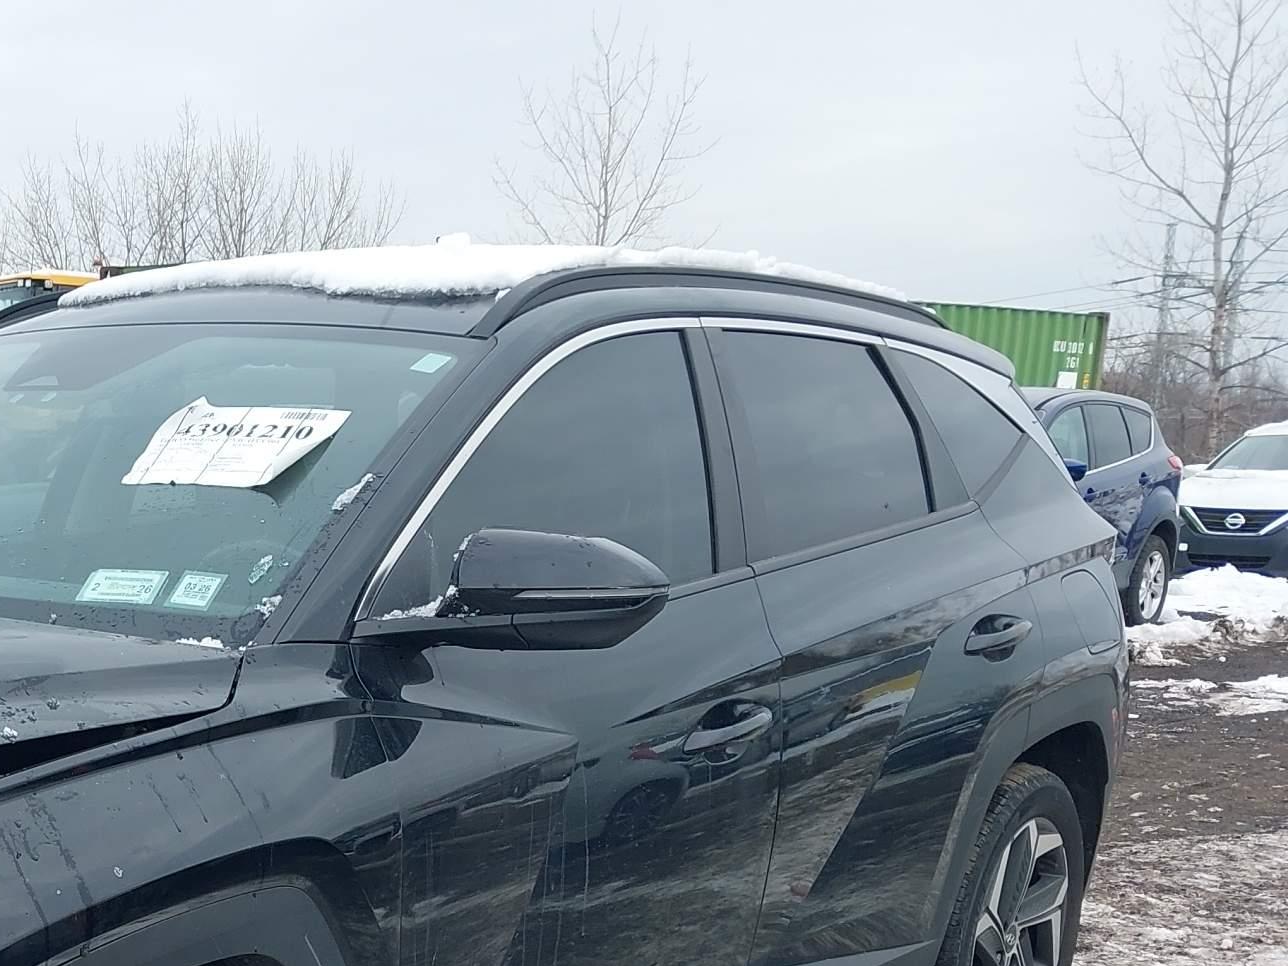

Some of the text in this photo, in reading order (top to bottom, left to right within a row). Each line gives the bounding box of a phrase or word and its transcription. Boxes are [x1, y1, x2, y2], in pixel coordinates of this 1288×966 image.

[176, 424, 314, 440] 43901210
[92, 582, 101, 592] 2
[136, 584, 153, 594] 26
